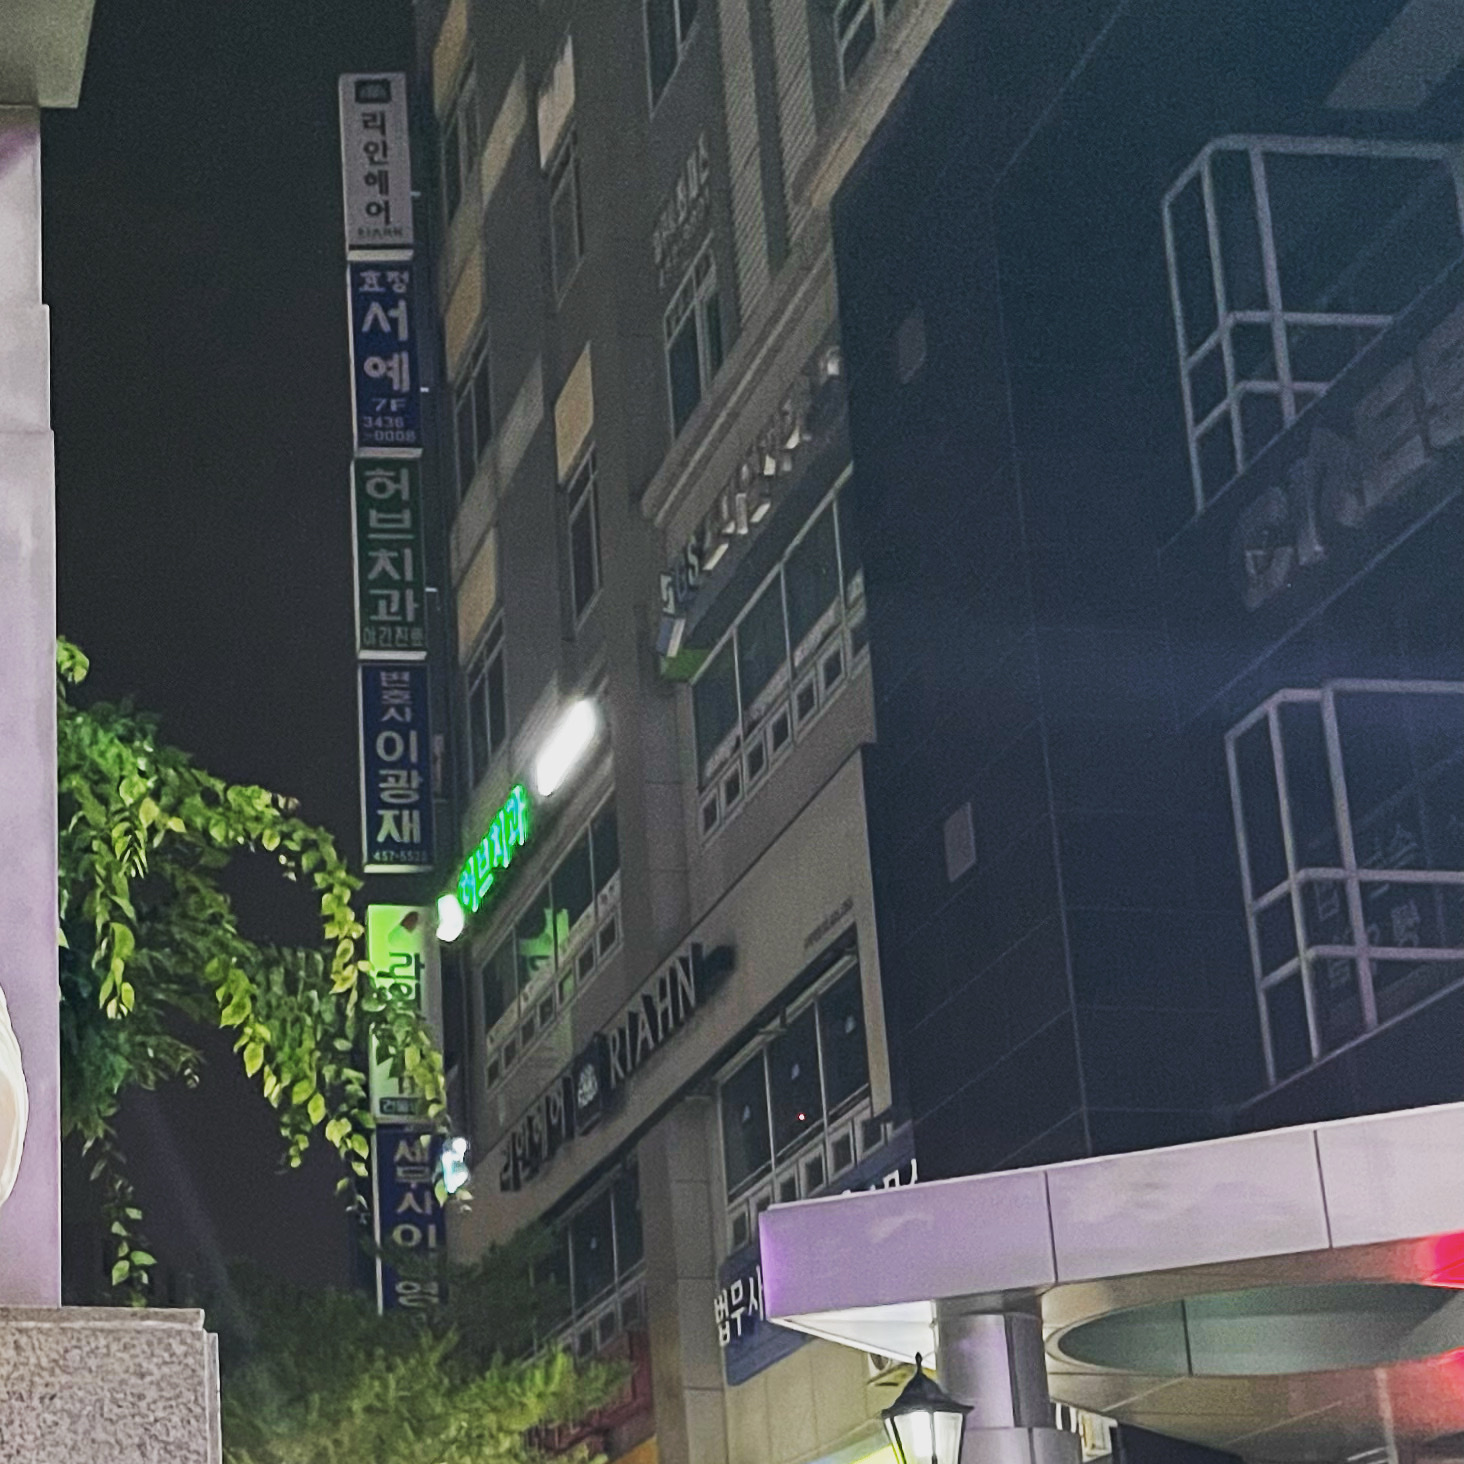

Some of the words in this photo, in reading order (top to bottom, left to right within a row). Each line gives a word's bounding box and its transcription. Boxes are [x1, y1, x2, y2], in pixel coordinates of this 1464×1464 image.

[361, 299, 411, 393] 서예
[371, 397, 407, 412] 7F
[363, 466, 420, 625] 허브치과
[378, 670, 414, 725] 변호사
[374, 729, 424, 846] 이광재
[459, 785, 527, 912] 허브치과
[607, 945, 700, 1090] RIAHN
[393, 1139, 434, 1216] 세무사
[713, 1264, 765, 1347] 법무사
